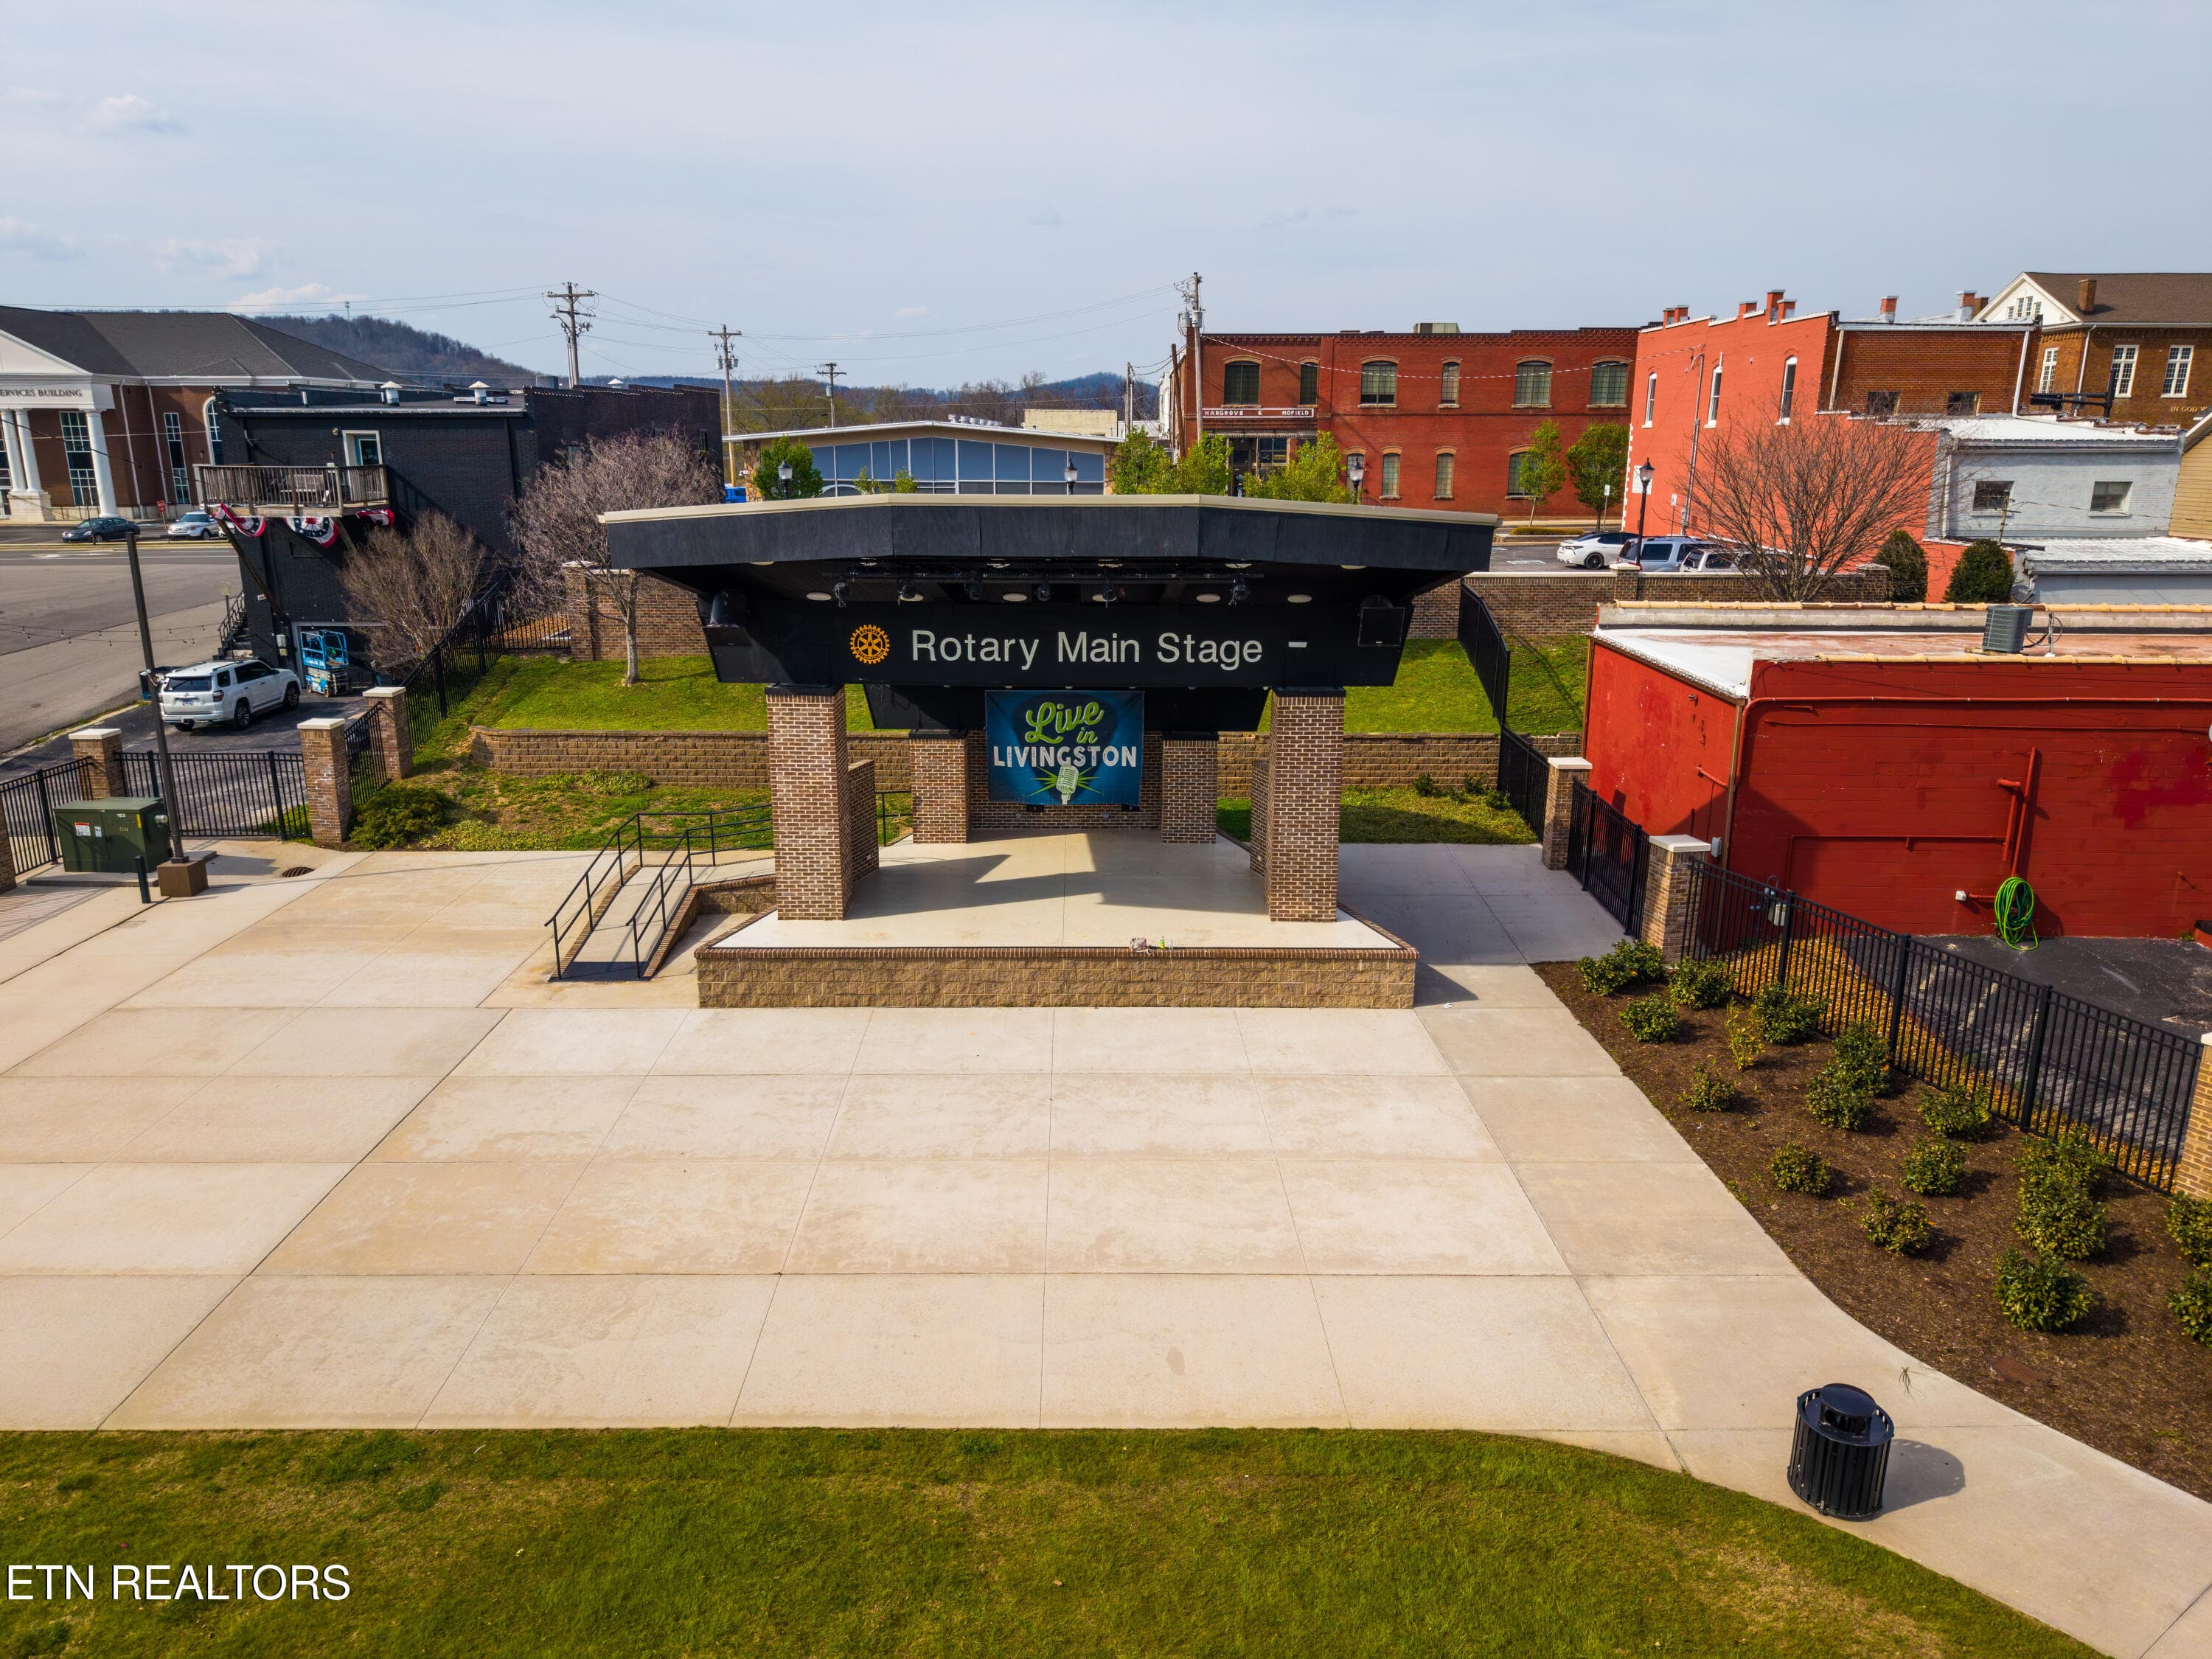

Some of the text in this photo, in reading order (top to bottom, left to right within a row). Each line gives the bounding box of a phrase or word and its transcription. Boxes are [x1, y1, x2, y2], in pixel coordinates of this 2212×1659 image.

[912, 630, 1262, 671] Rotary Main Stage
[1025, 701, 1105, 744] Live
[1076, 726, 1099, 744] in
[993, 745, 1136, 768] LIVINGSTON
